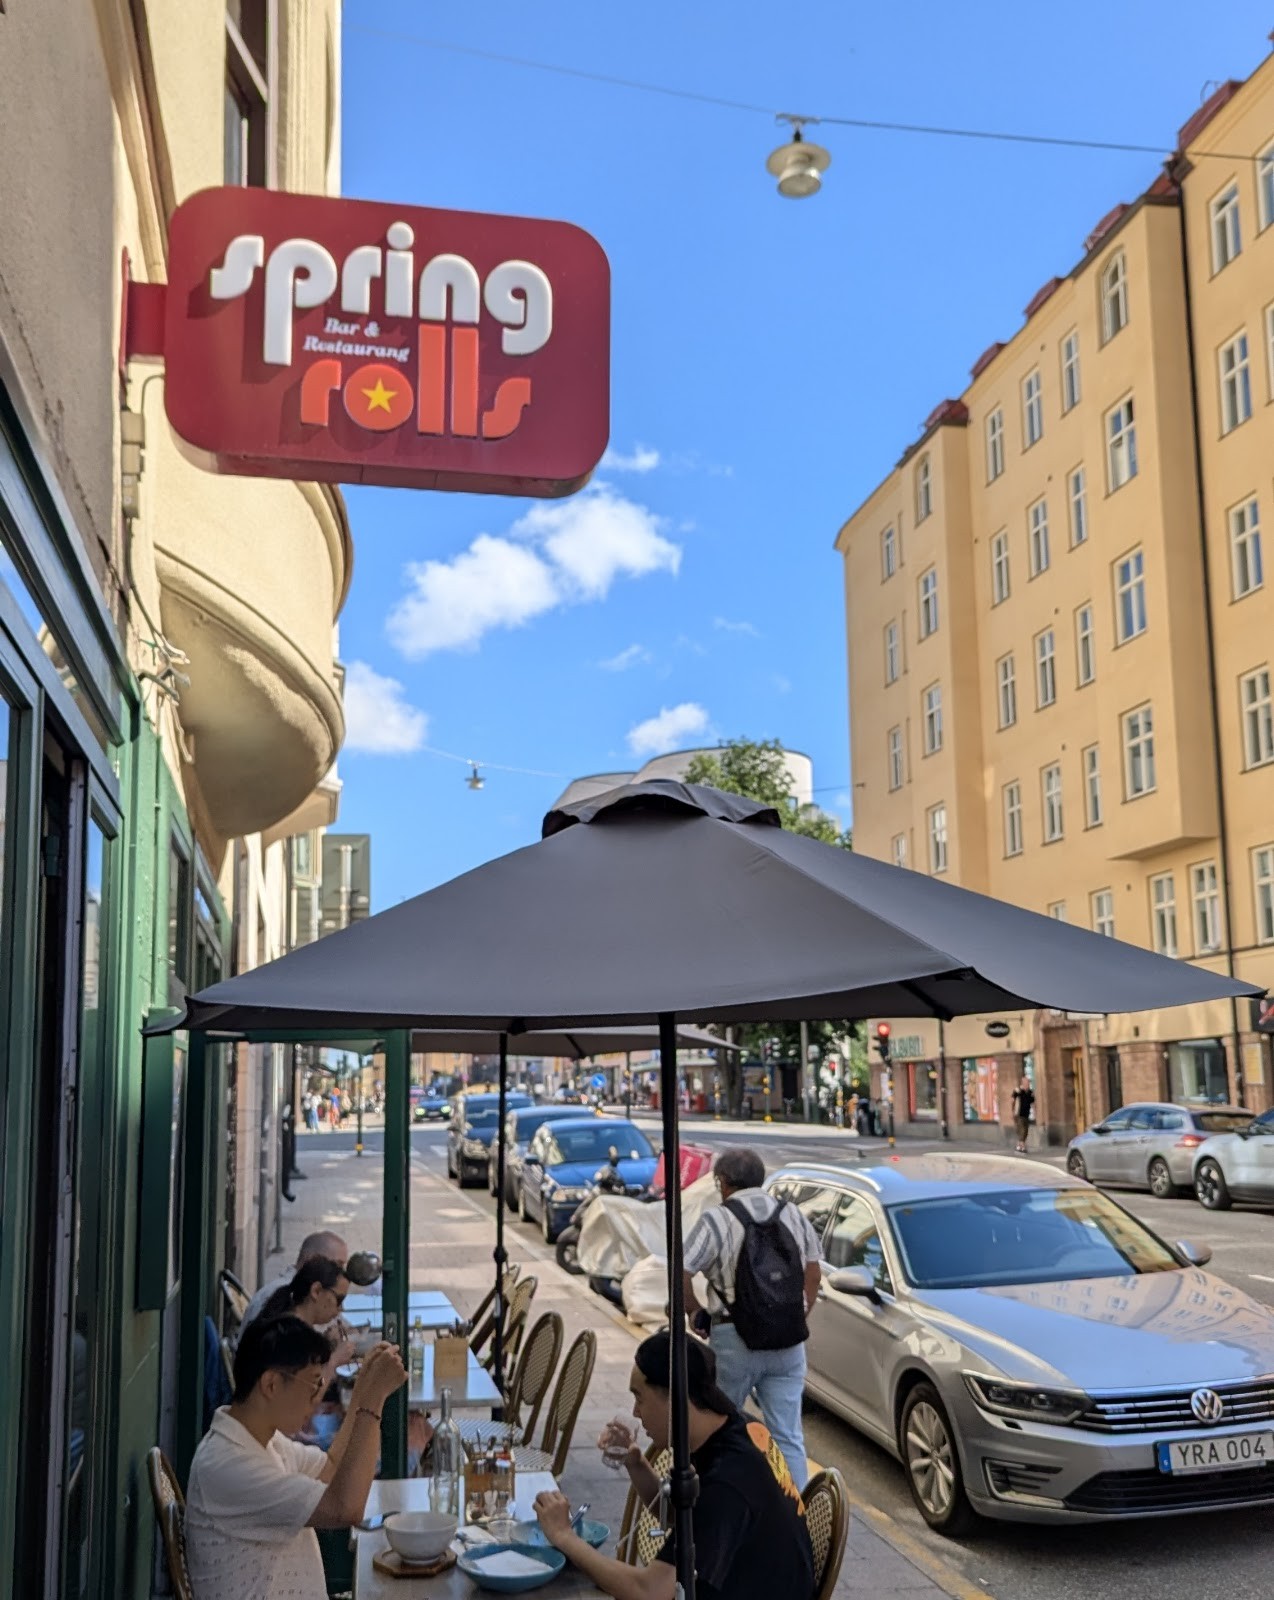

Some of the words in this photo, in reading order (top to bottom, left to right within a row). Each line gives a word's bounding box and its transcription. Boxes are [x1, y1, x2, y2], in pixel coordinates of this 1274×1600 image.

[211, 221, 553, 366] spring
[324, 317, 361, 335] Bar
[364, 321, 380, 338] &
[303, 335, 411, 363] Restaurang
[301, 324, 532, 439] rolls
[1178, 1442, 1220, 1466] YRA
[1226, 1437, 1266, 1461] 004
